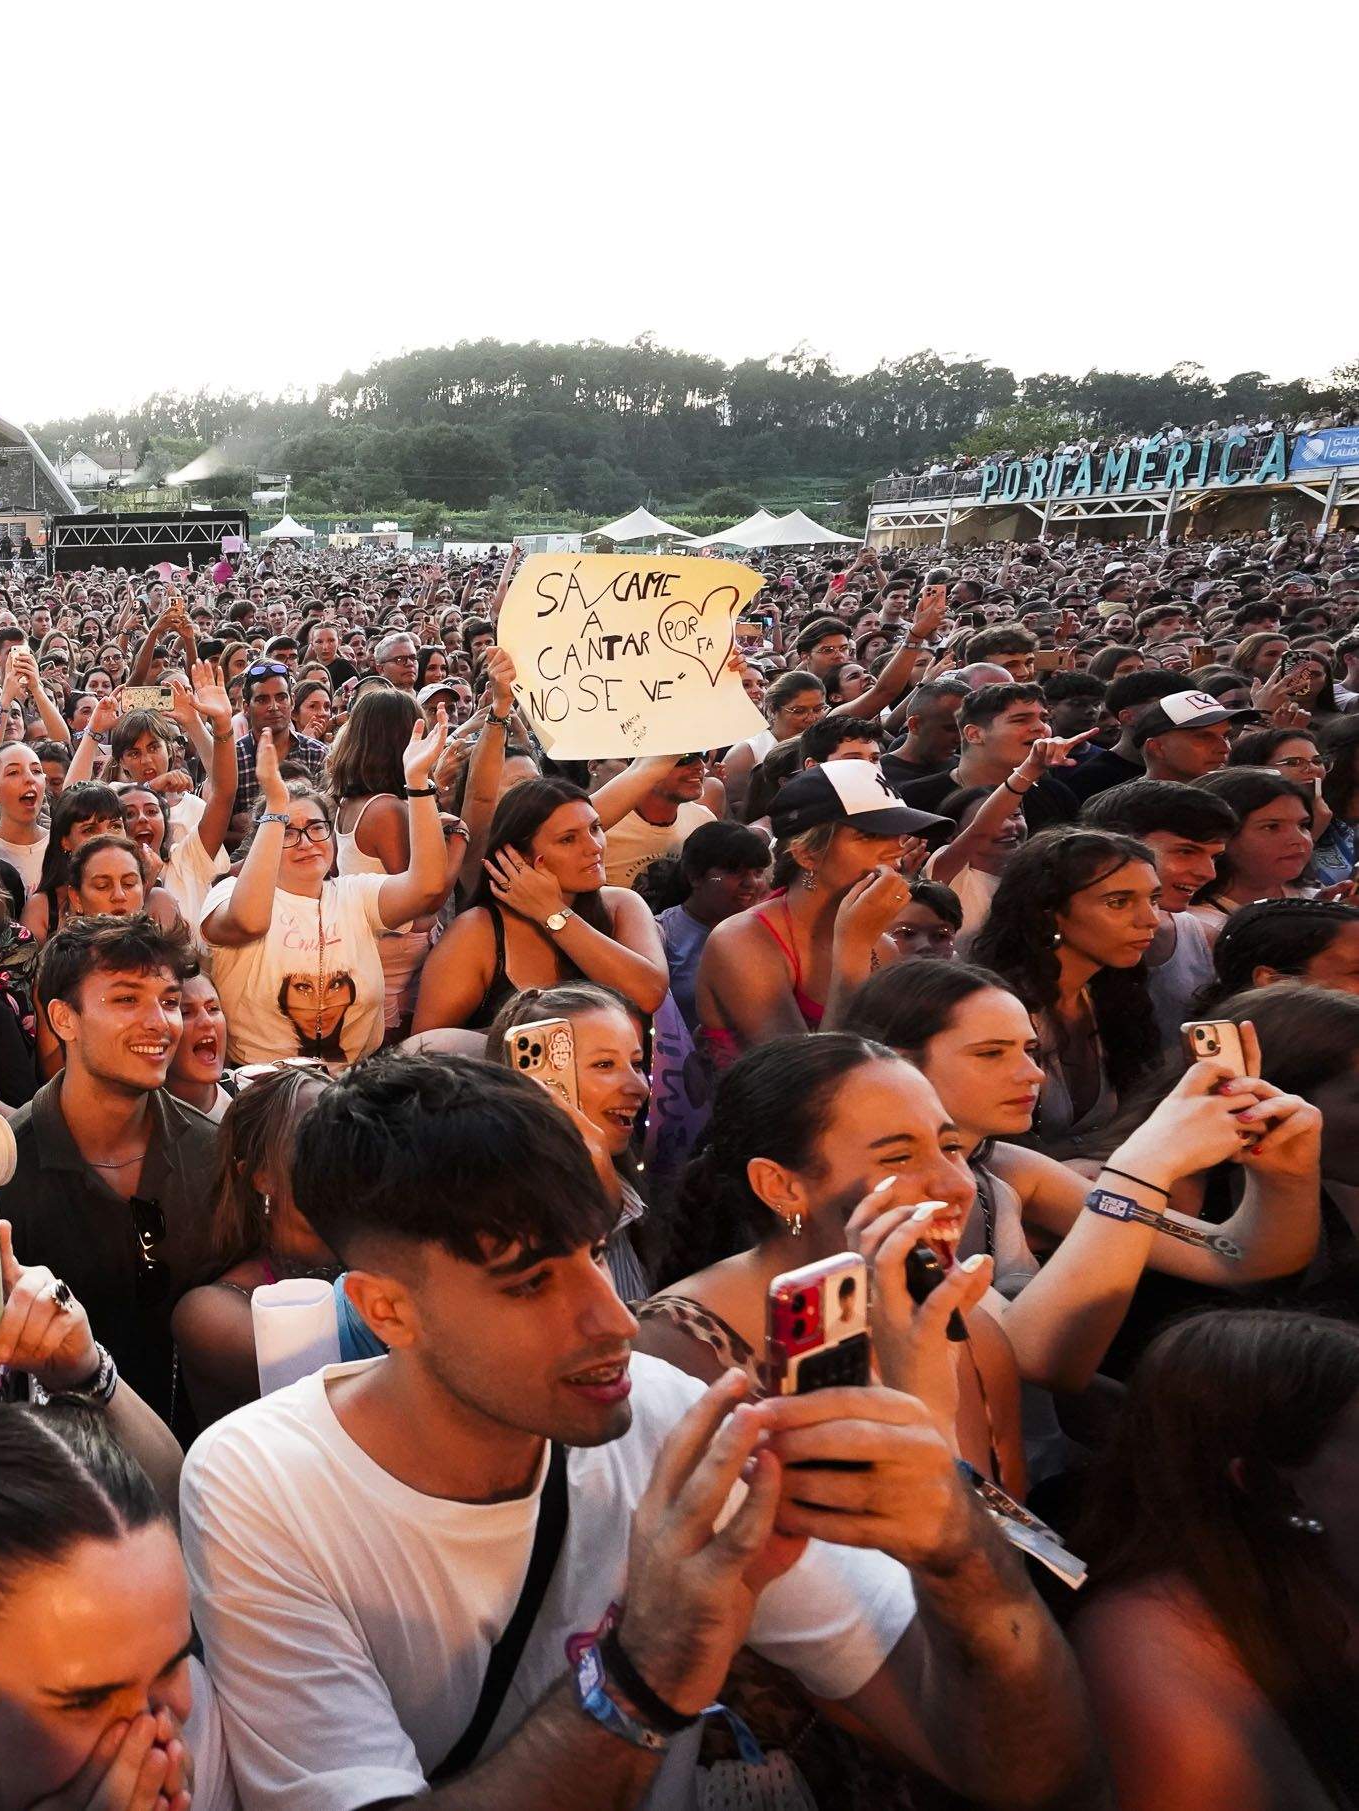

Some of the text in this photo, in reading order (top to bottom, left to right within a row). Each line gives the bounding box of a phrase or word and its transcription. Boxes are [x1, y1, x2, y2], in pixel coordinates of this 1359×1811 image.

[980, 431, 1286, 503] PORTAMÉRICA
[581, 610, 603, 638] A
[664, 616, 698, 642] POR
[538, 631, 650, 680] CANTAR
[697, 636, 714, 654] FA
[578, 675, 622, 712] SE
